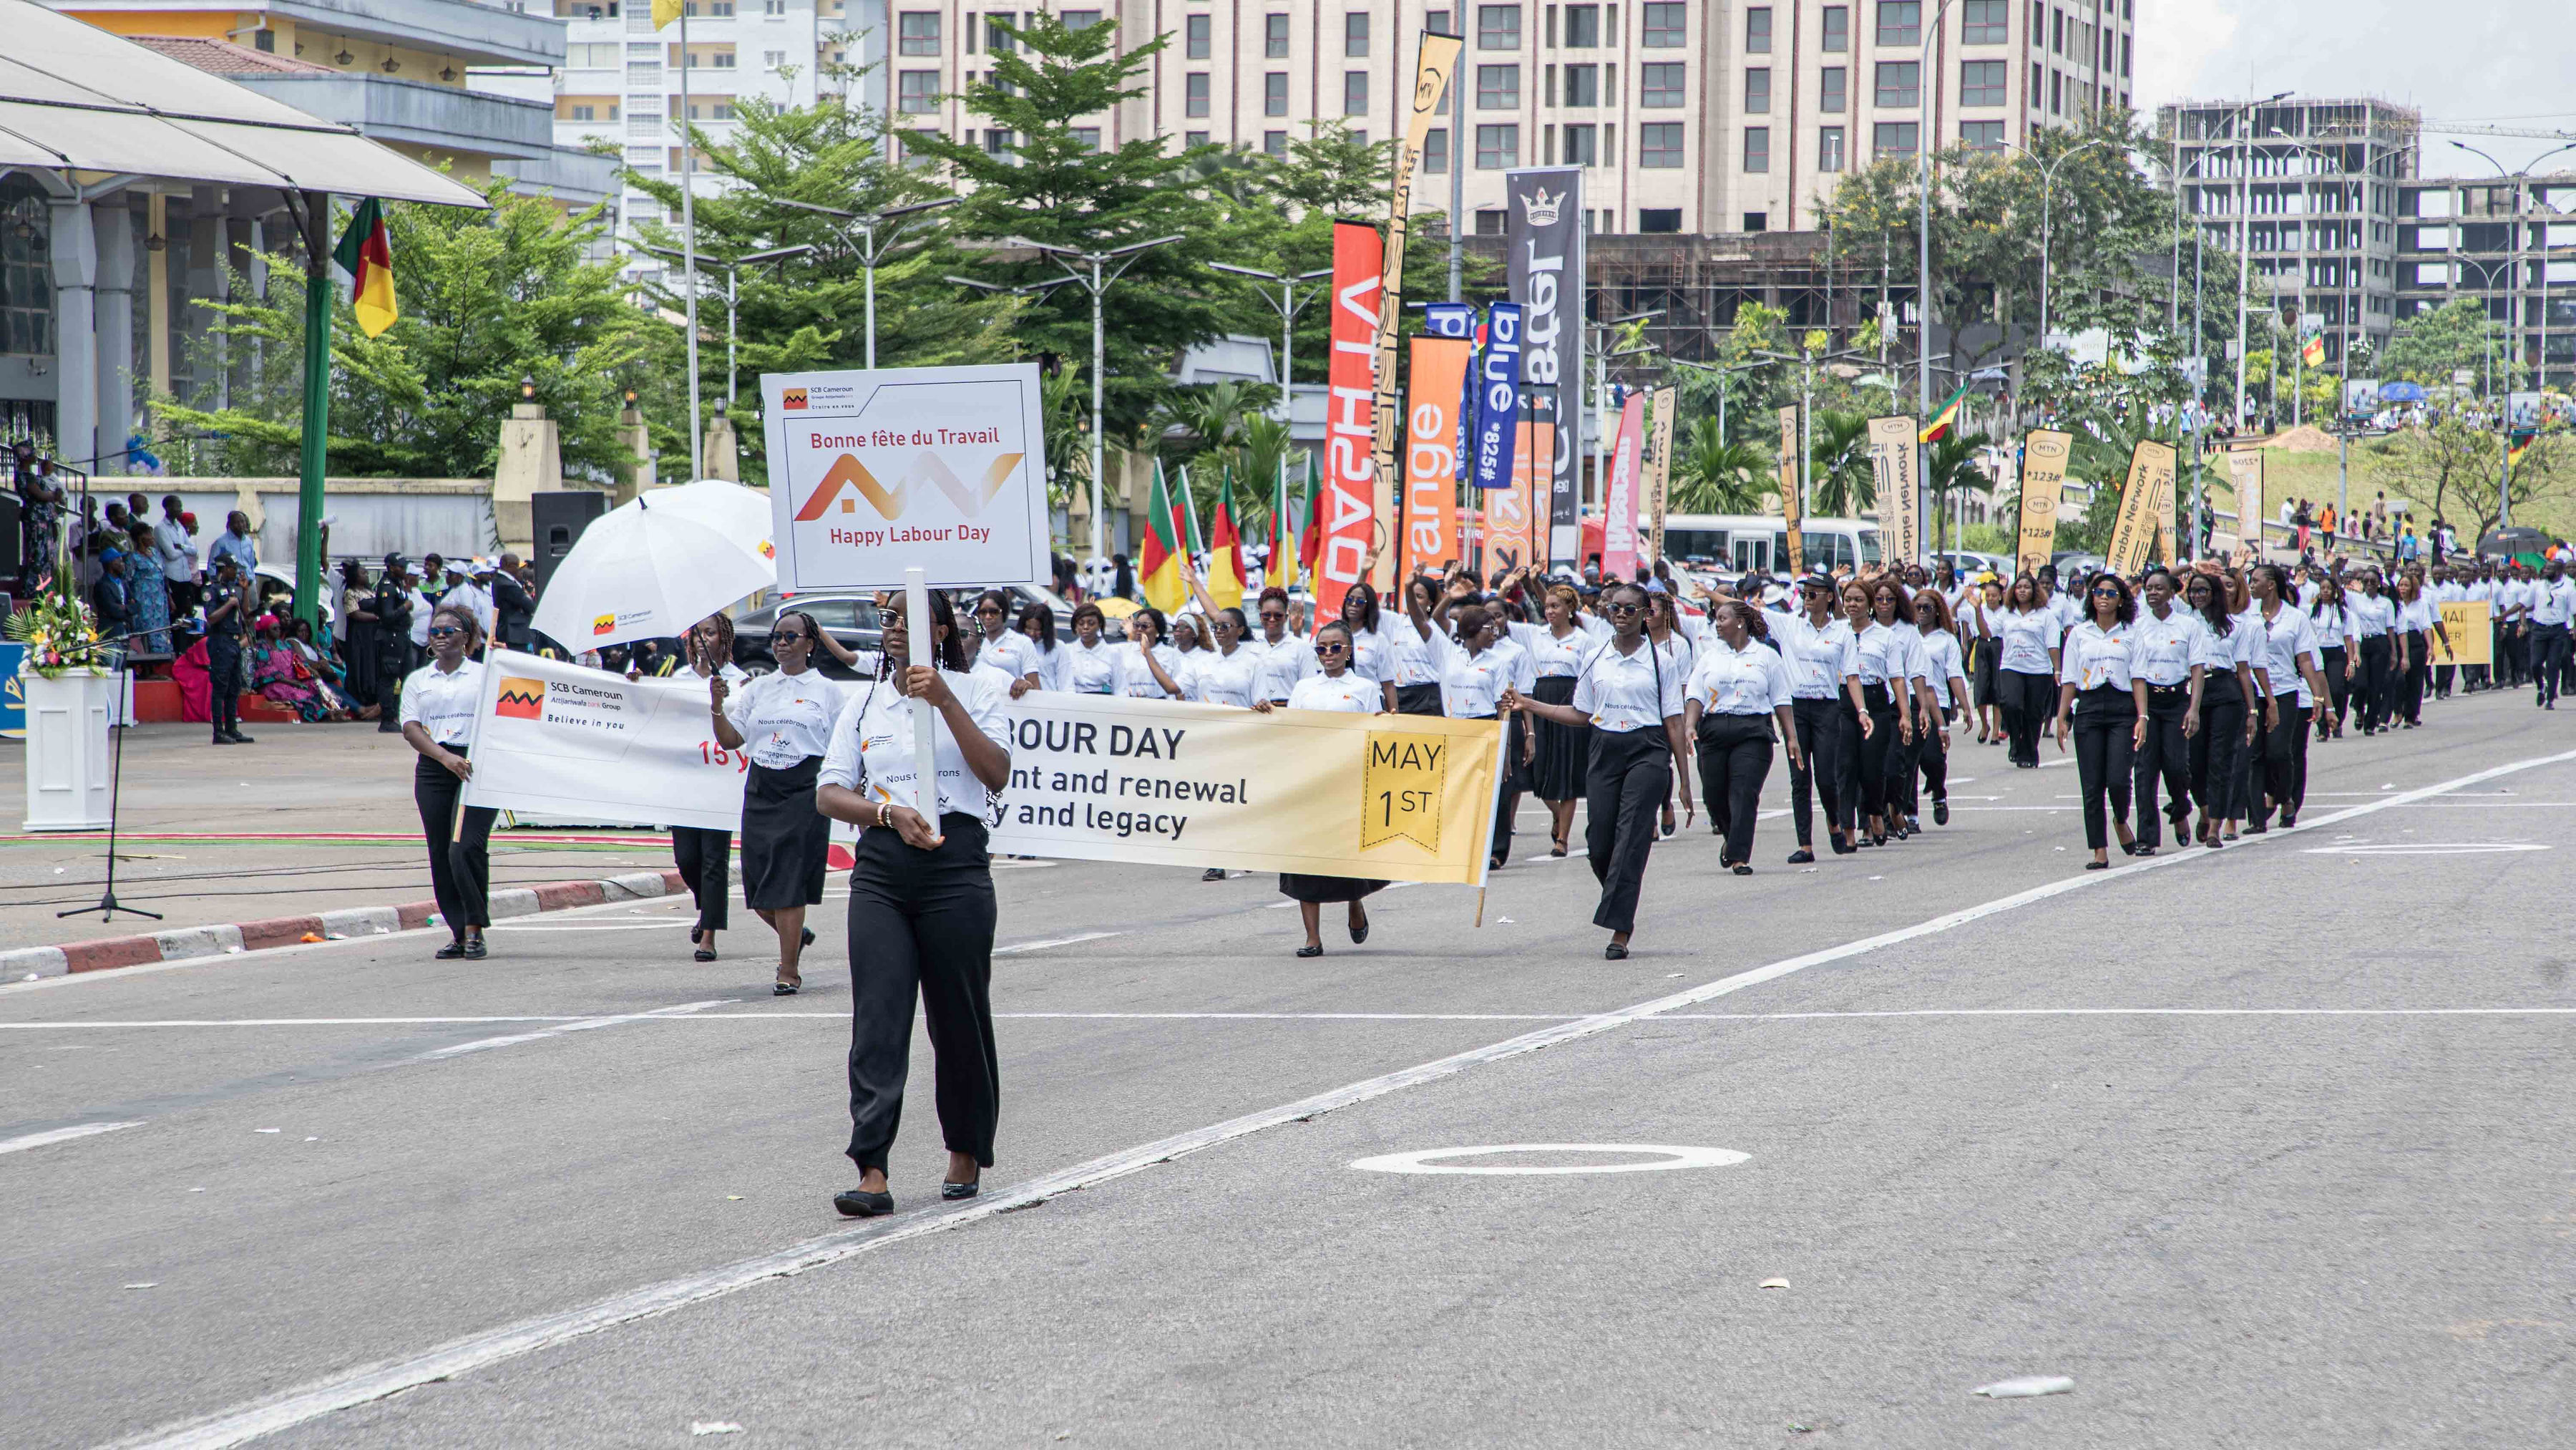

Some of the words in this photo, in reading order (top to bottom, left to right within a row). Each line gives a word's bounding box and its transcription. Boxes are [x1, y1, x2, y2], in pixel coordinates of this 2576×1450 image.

[1485, 311, 1519, 412] blue
[811, 432, 867, 449] Bonne
[872, 429, 906, 447] fête
[912, 429, 933, 446] du
[938, 427, 1000, 444] Travail
[2039, 444, 2057, 454] MTN
[1407, 402, 1455, 575] range
[2126, 463, 2149, 523] Network
[830, 527, 885, 547] Happy
[890, 526, 952, 542] Labour
[958, 525, 990, 544] Day
[551, 681, 570, 692] SCB
[572, 685, 623, 700] Cameroun
[602, 702, 621, 711] Group
[547, 714, 587, 726] Believe
[606, 721, 625, 730] you
[776, 718, 808, 730] célébrons
[698, 741, 729, 766] 15
[1110, 725, 1186, 760] DAY
[1372, 741, 1442, 771] MAY
[887, 773, 911, 784] Nous
[1051, 769, 1108, 794] and
[1119, 777, 1248, 804] renewal
[1018, 802, 1075, 827] and
[1086, 803, 1188, 841] legacy
